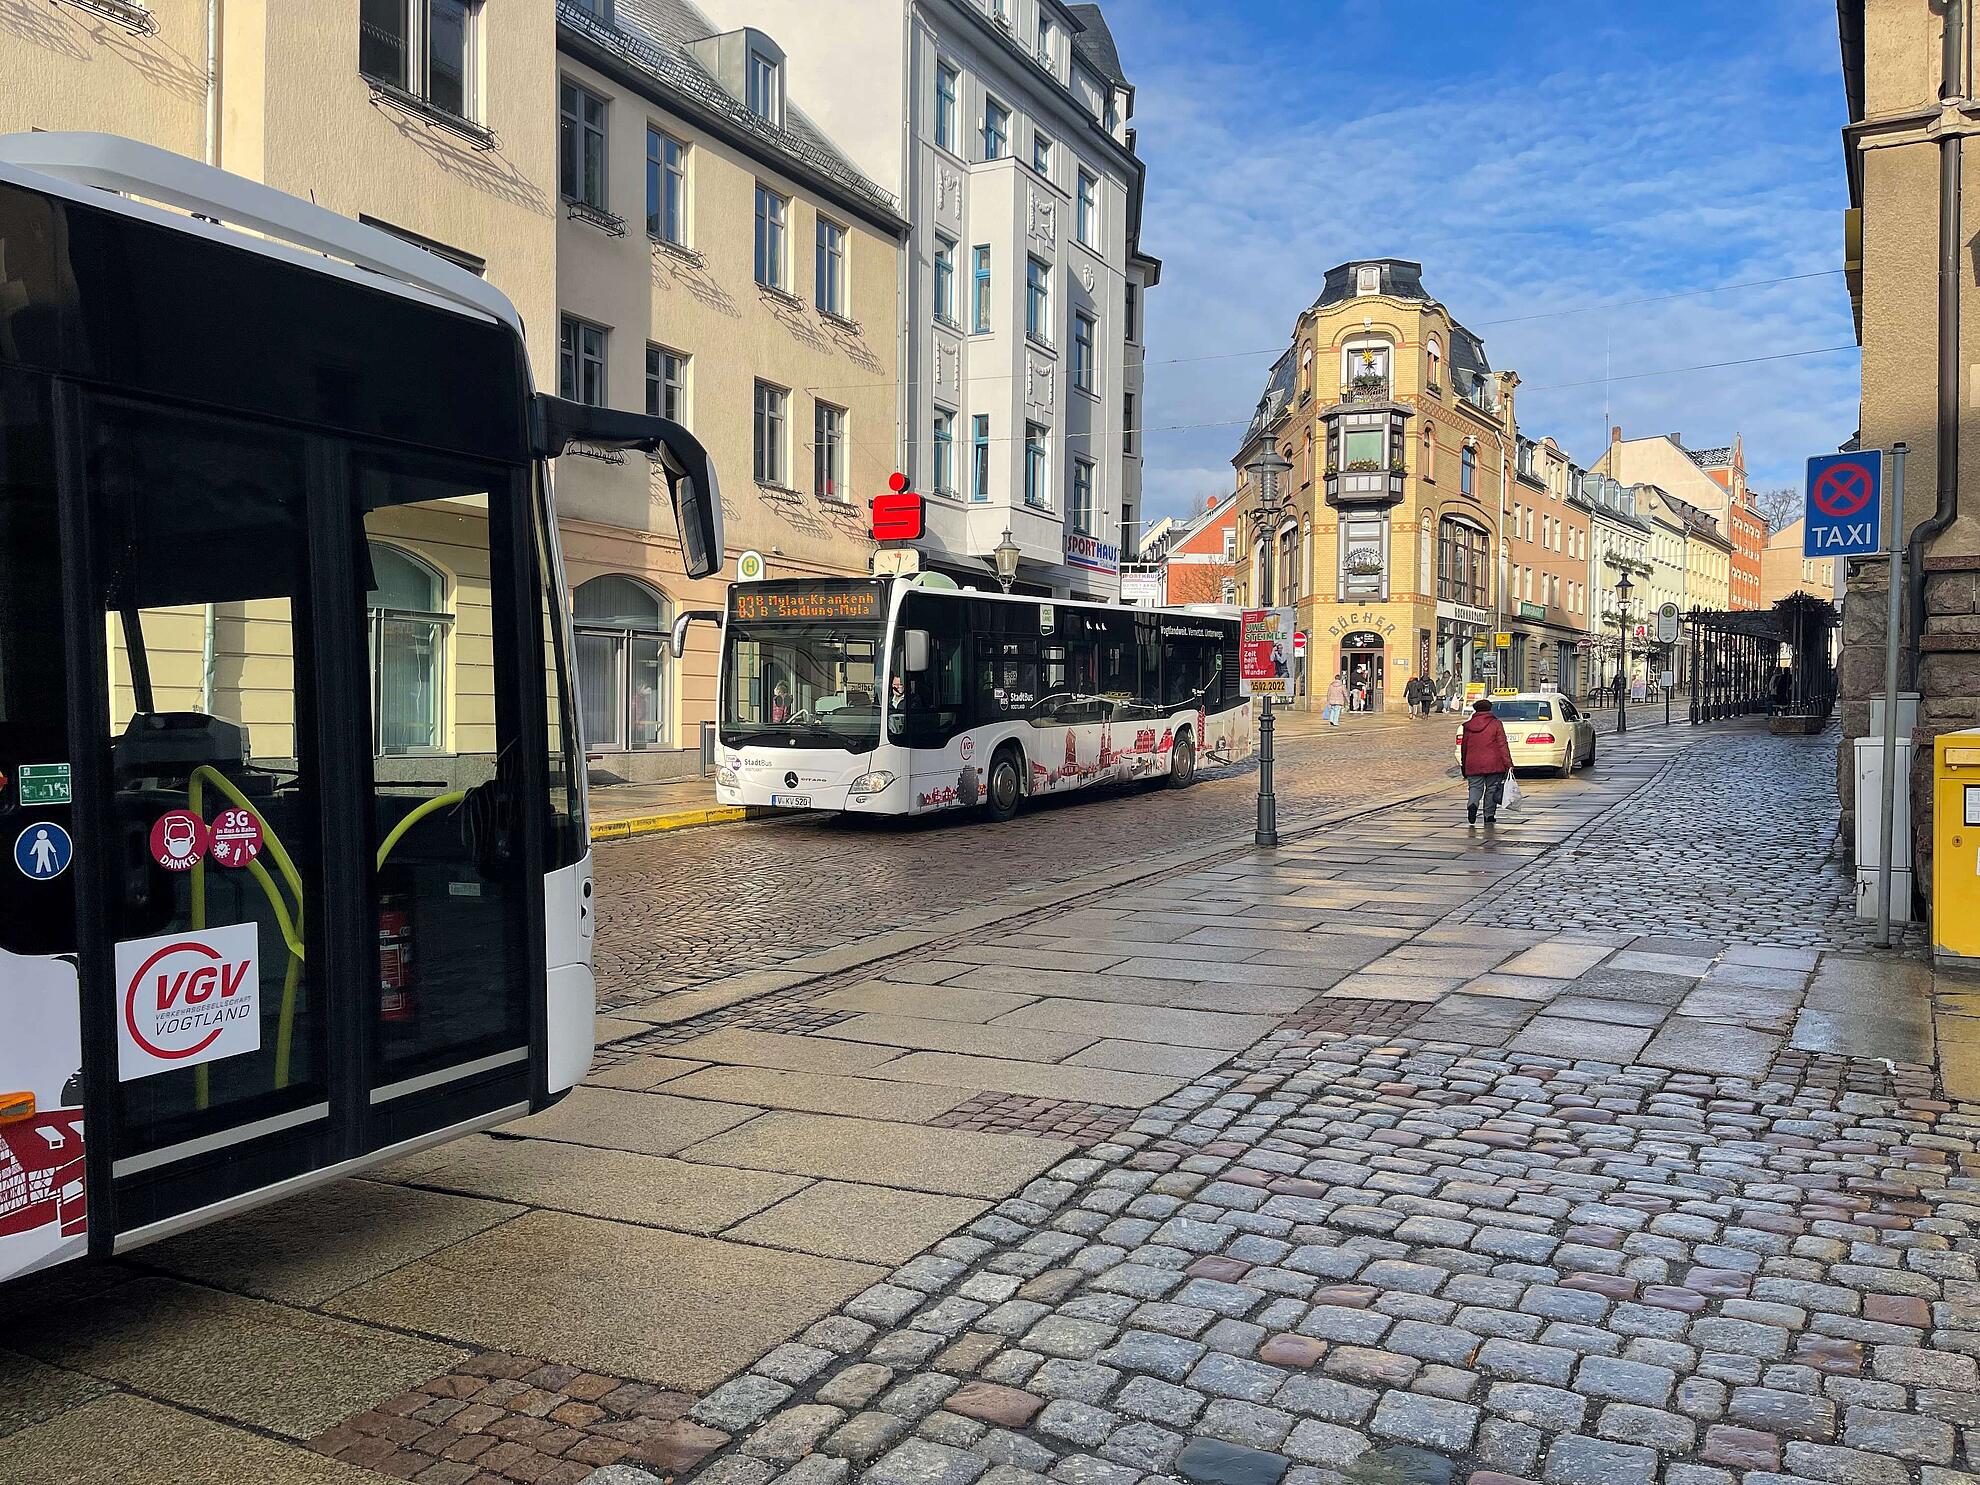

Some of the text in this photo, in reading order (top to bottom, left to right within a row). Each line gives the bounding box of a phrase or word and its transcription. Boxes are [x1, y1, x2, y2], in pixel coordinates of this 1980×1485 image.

[1812, 523, 1871, 548] TAXI
[1067, 535, 1117, 562] SPORTHAUS
[1246, 622, 1265, 631] UWE
[1328, 612, 1396, 636] BÜCHER
[1245, 632, 1287, 642] STEIMLE
[1010, 691, 1033, 702] StadtBus
[744, 758, 772, 767] StadtBus
[225, 810, 249, 828] 3G
[160, 852, 200, 869] DANKE!
[156, 960, 252, 1011] VGV
[155, 995, 252, 1020] VERKEHRSGESELLSCHAFT
[156, 1004, 250, 1036] VOGTLAND
